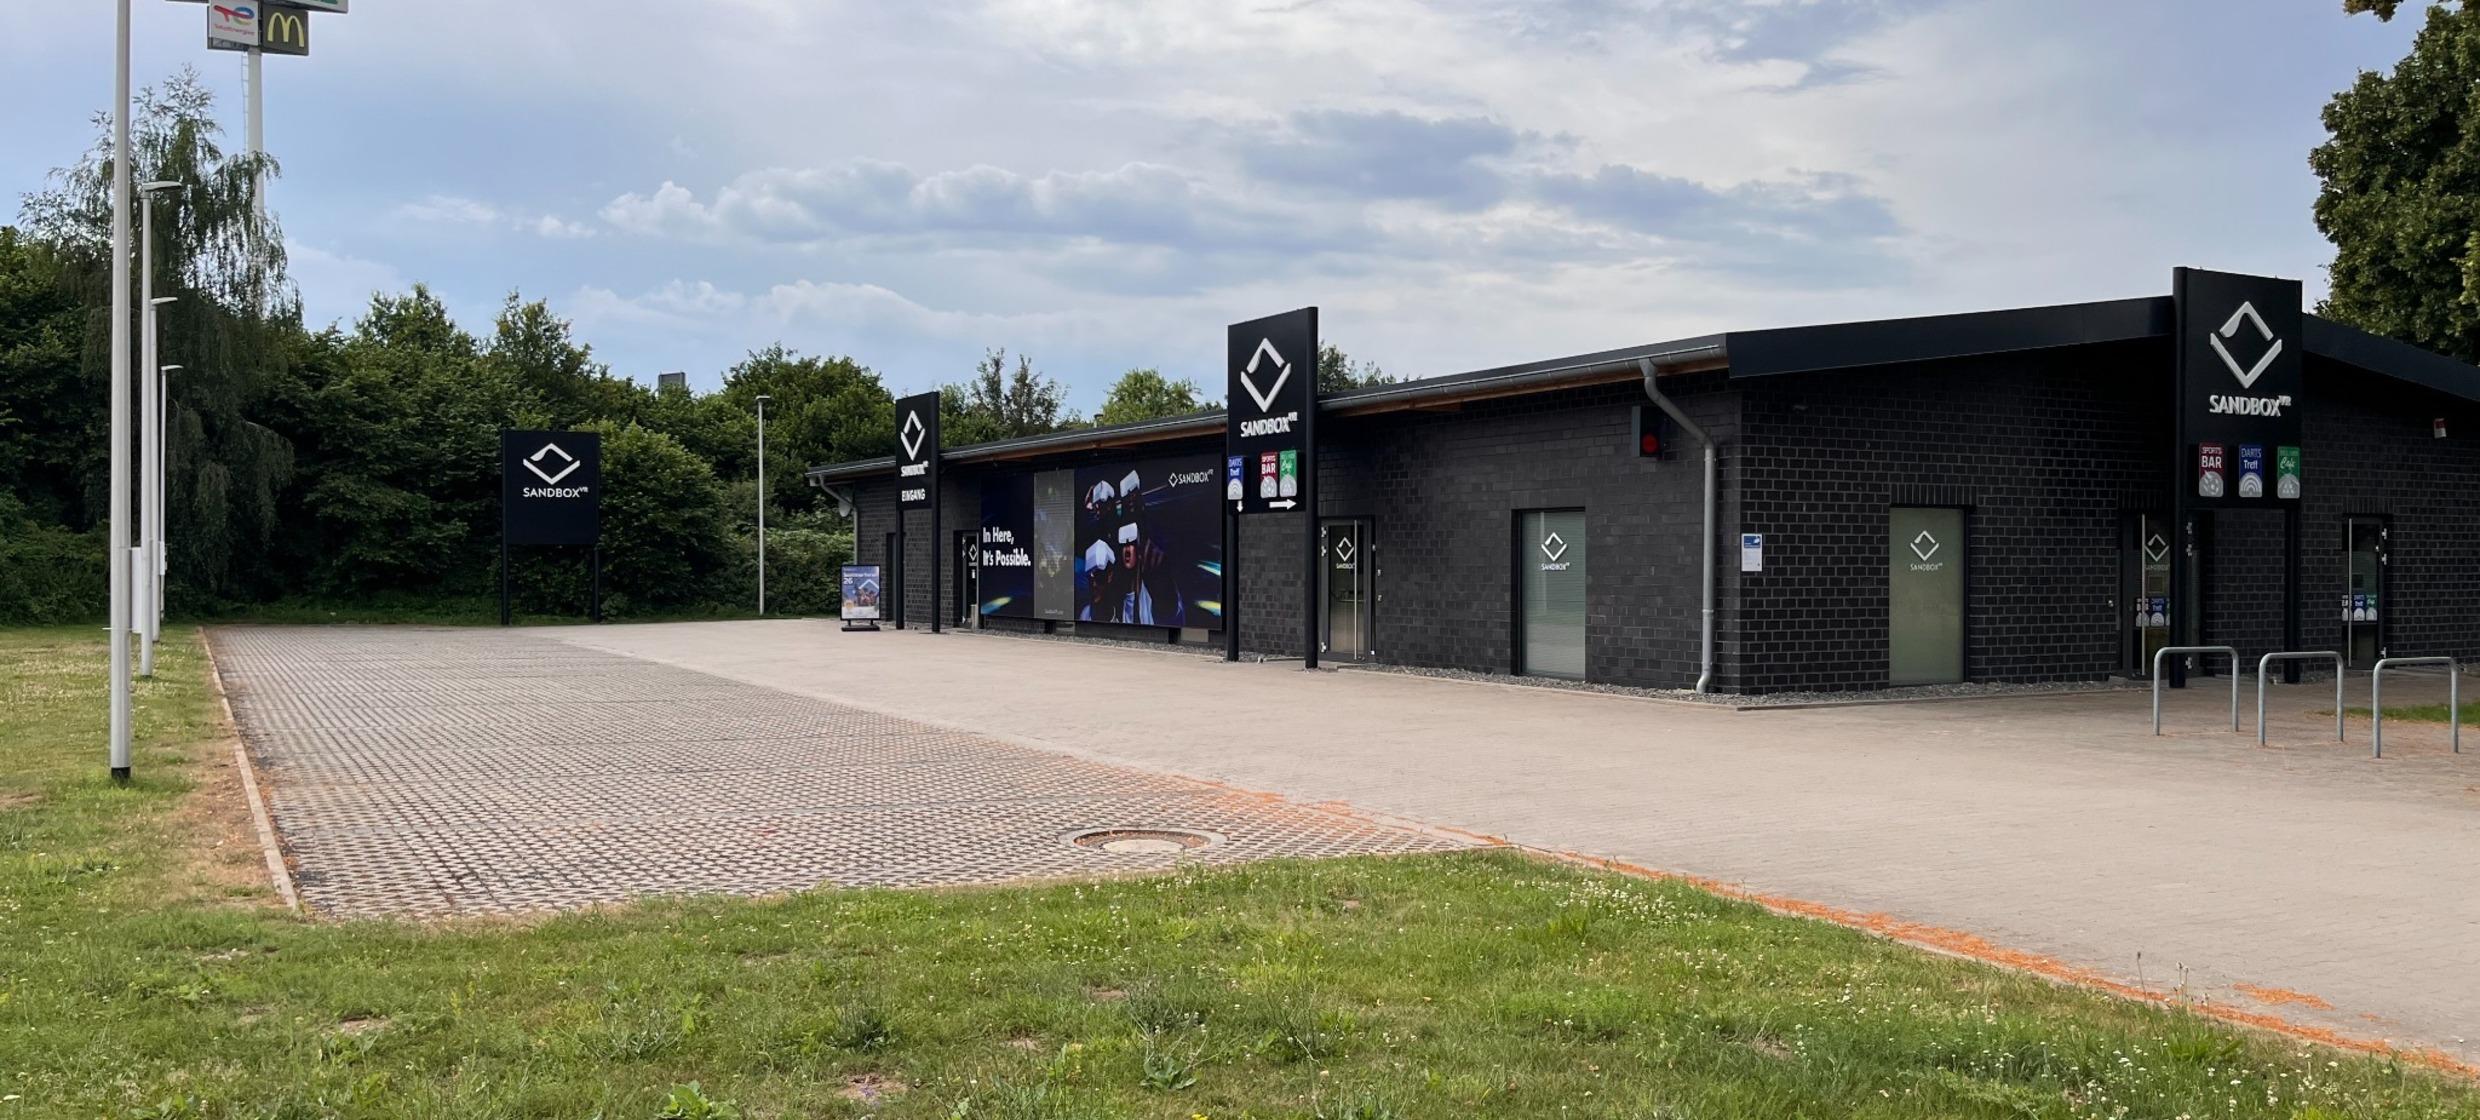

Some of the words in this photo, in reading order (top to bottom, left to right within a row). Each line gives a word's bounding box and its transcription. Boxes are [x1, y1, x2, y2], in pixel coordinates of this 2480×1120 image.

[2201, 446, 2222, 455] SPORTS
[2240, 447, 2262, 458] DARTS
[1261, 462, 1276, 475] BAR
[2201, 455, 2222, 469] BAR
[901, 488, 926, 502] EINGANG
[982, 526, 992, 543] In
[992, 526, 1015, 545] Here,
[982, 549, 994, 567] It's
[995, 547, 1032, 567] Possible.
